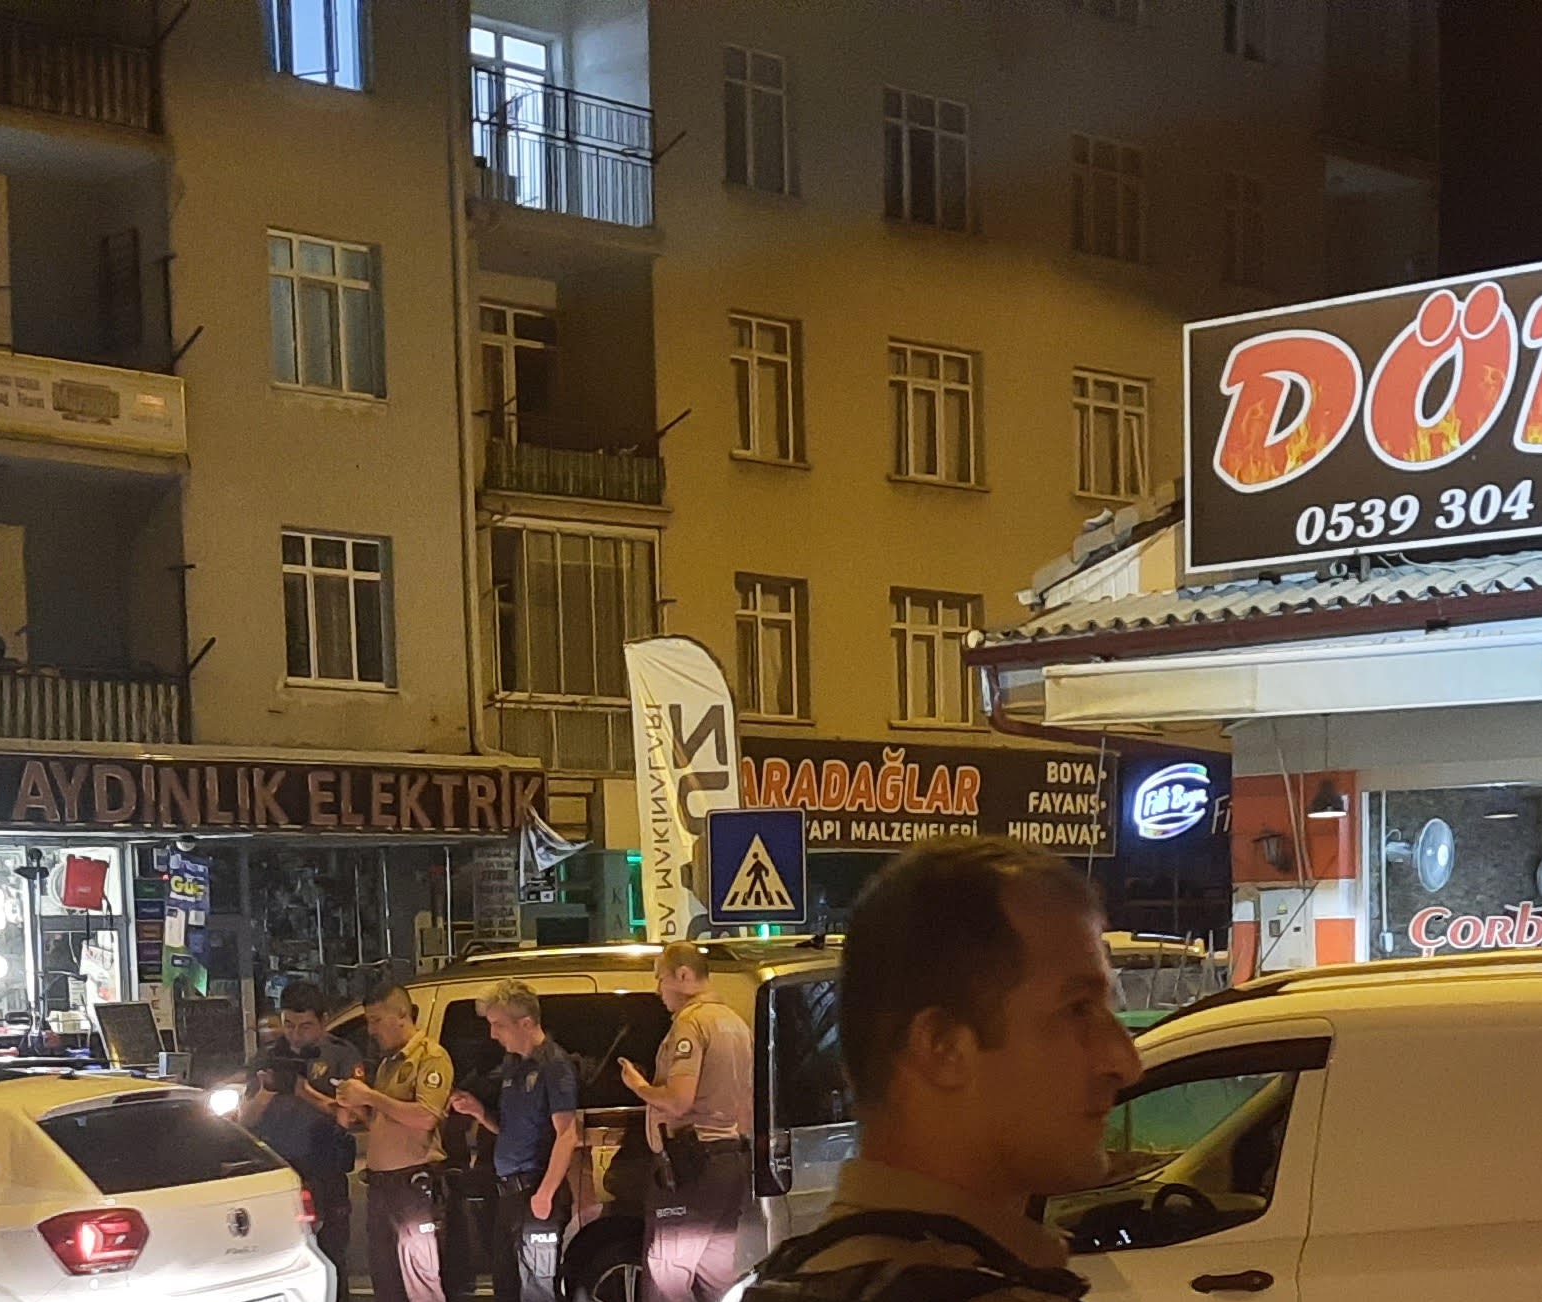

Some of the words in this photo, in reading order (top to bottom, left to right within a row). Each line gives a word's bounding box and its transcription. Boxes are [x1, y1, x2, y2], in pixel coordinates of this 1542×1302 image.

[1295, 496, 1420, 548] 0539
[1435, 479, 1534, 531] 304
[1046, 761, 1095, 783] BOYA
[12, 760, 292, 828] AYDINLIK
[1028, 791, 1100, 815] FAYANS
[1007, 822, 1100, 847] HIRDAVAT
